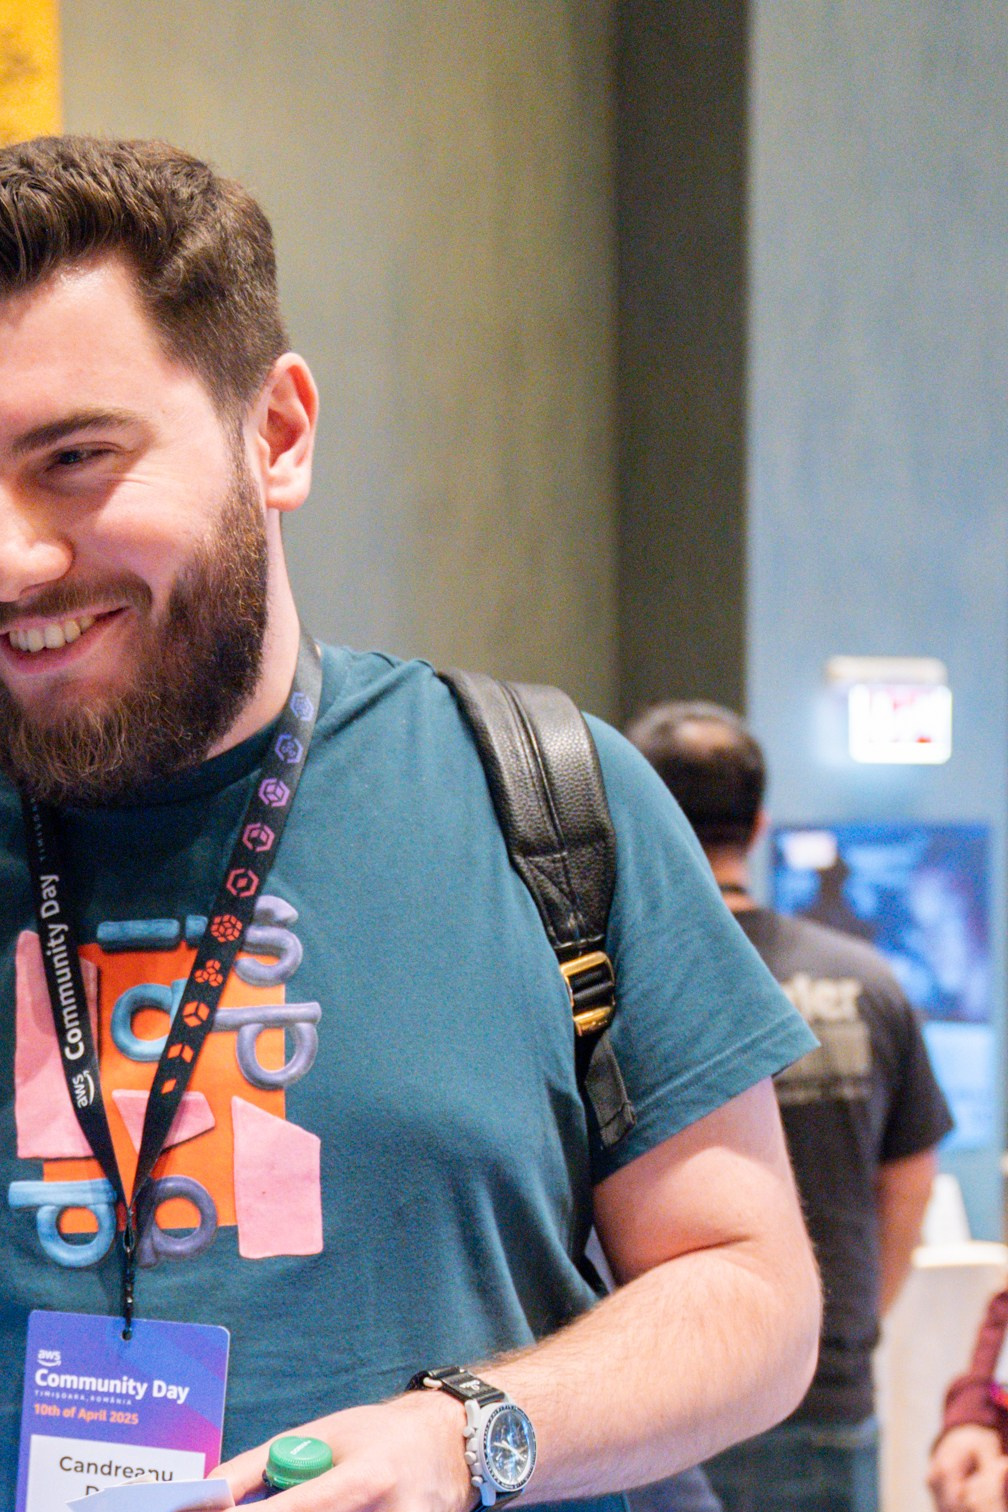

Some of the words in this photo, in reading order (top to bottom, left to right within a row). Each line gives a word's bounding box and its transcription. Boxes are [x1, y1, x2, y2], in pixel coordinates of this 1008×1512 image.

[39, 874, 59, 919] Day
[45, 924, 85, 1061] Community
[72, 1071, 92, 1108] aws
[37, 1350, 61, 1364] aws
[34, 1368, 148, 1400] Community
[151, 1380, 190, 1404] Day
[34, 1403, 61, 1418] 10th
[62, 1405, 77, 1419] of
[77, 1408, 107, 1424] April
[109, 1411, 140, 1425] 2025
[58, 1455, 174, 1483] Candreanu
